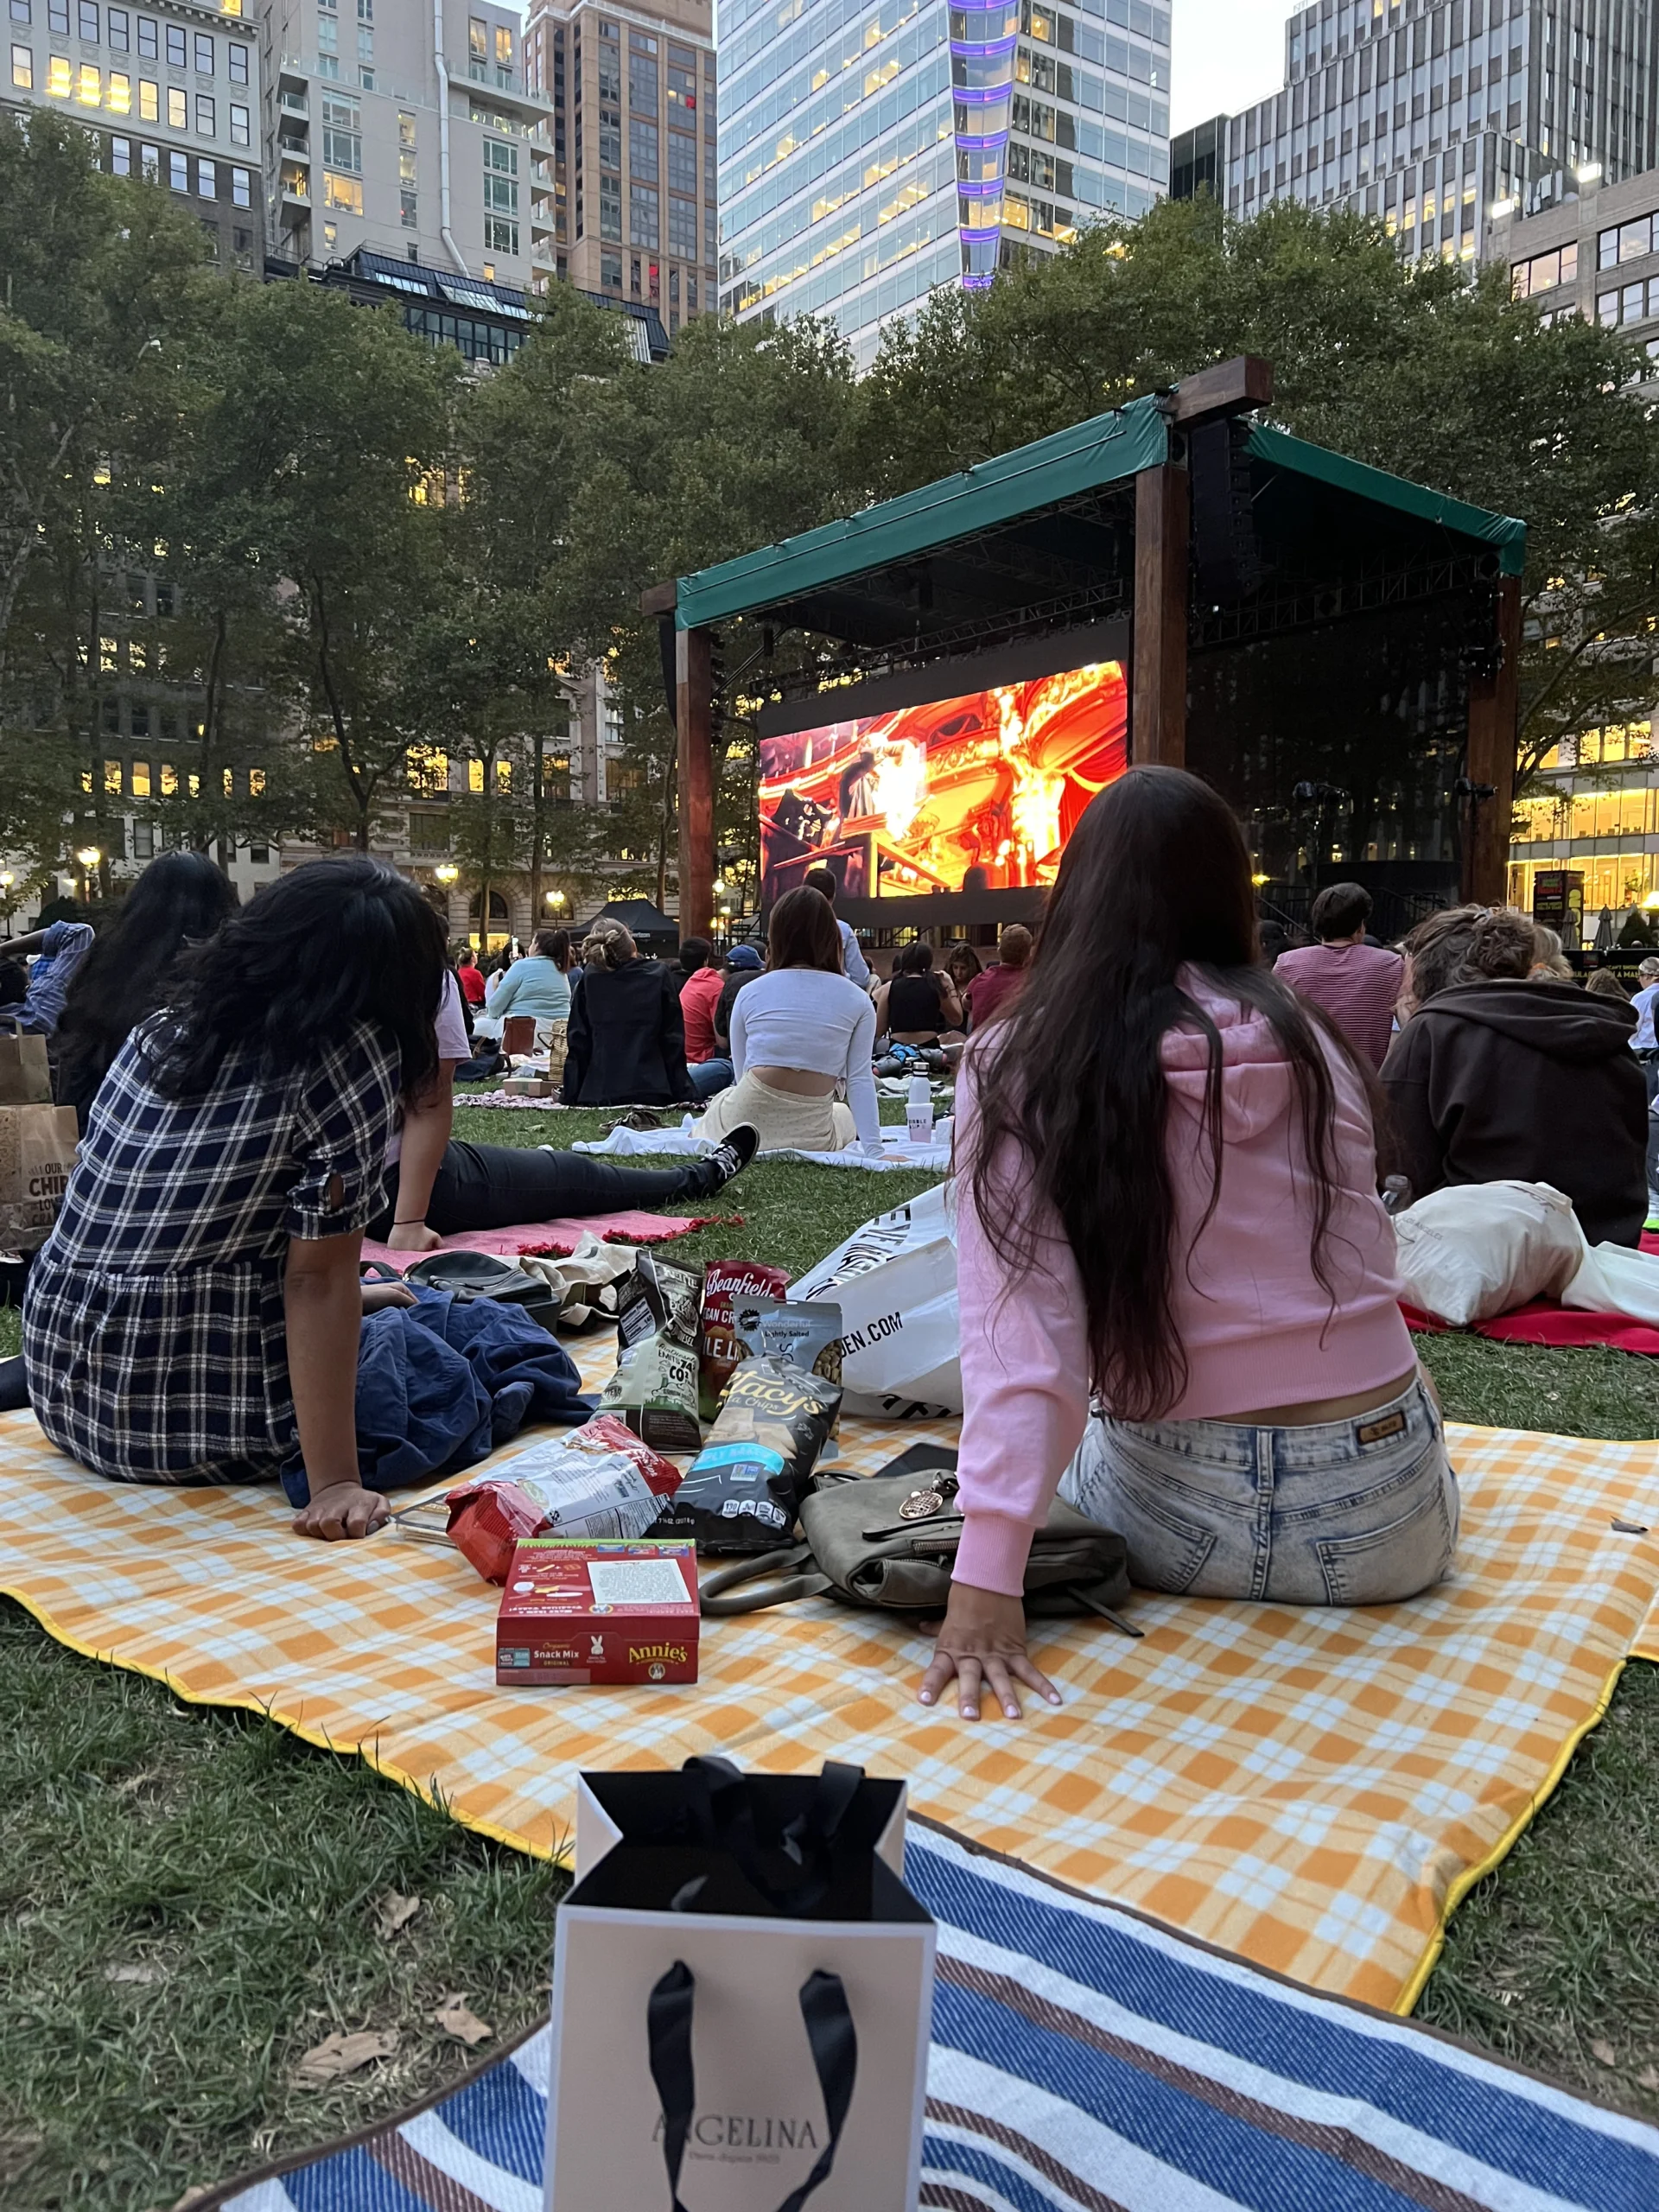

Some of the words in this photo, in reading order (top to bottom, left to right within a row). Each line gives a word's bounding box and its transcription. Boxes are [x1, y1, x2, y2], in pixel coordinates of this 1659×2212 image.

[45, 1163, 62, 1174] OUR
[29, 1175, 68, 1197] CHIP
[745, 1396, 779, 1412] Chips
[534, 1649, 561, 1659] Snack
[563, 1649, 580, 1658] Mix
[629, 1642, 688, 1664] Annie's
[652, 2114, 817, 2150] AGELINA
